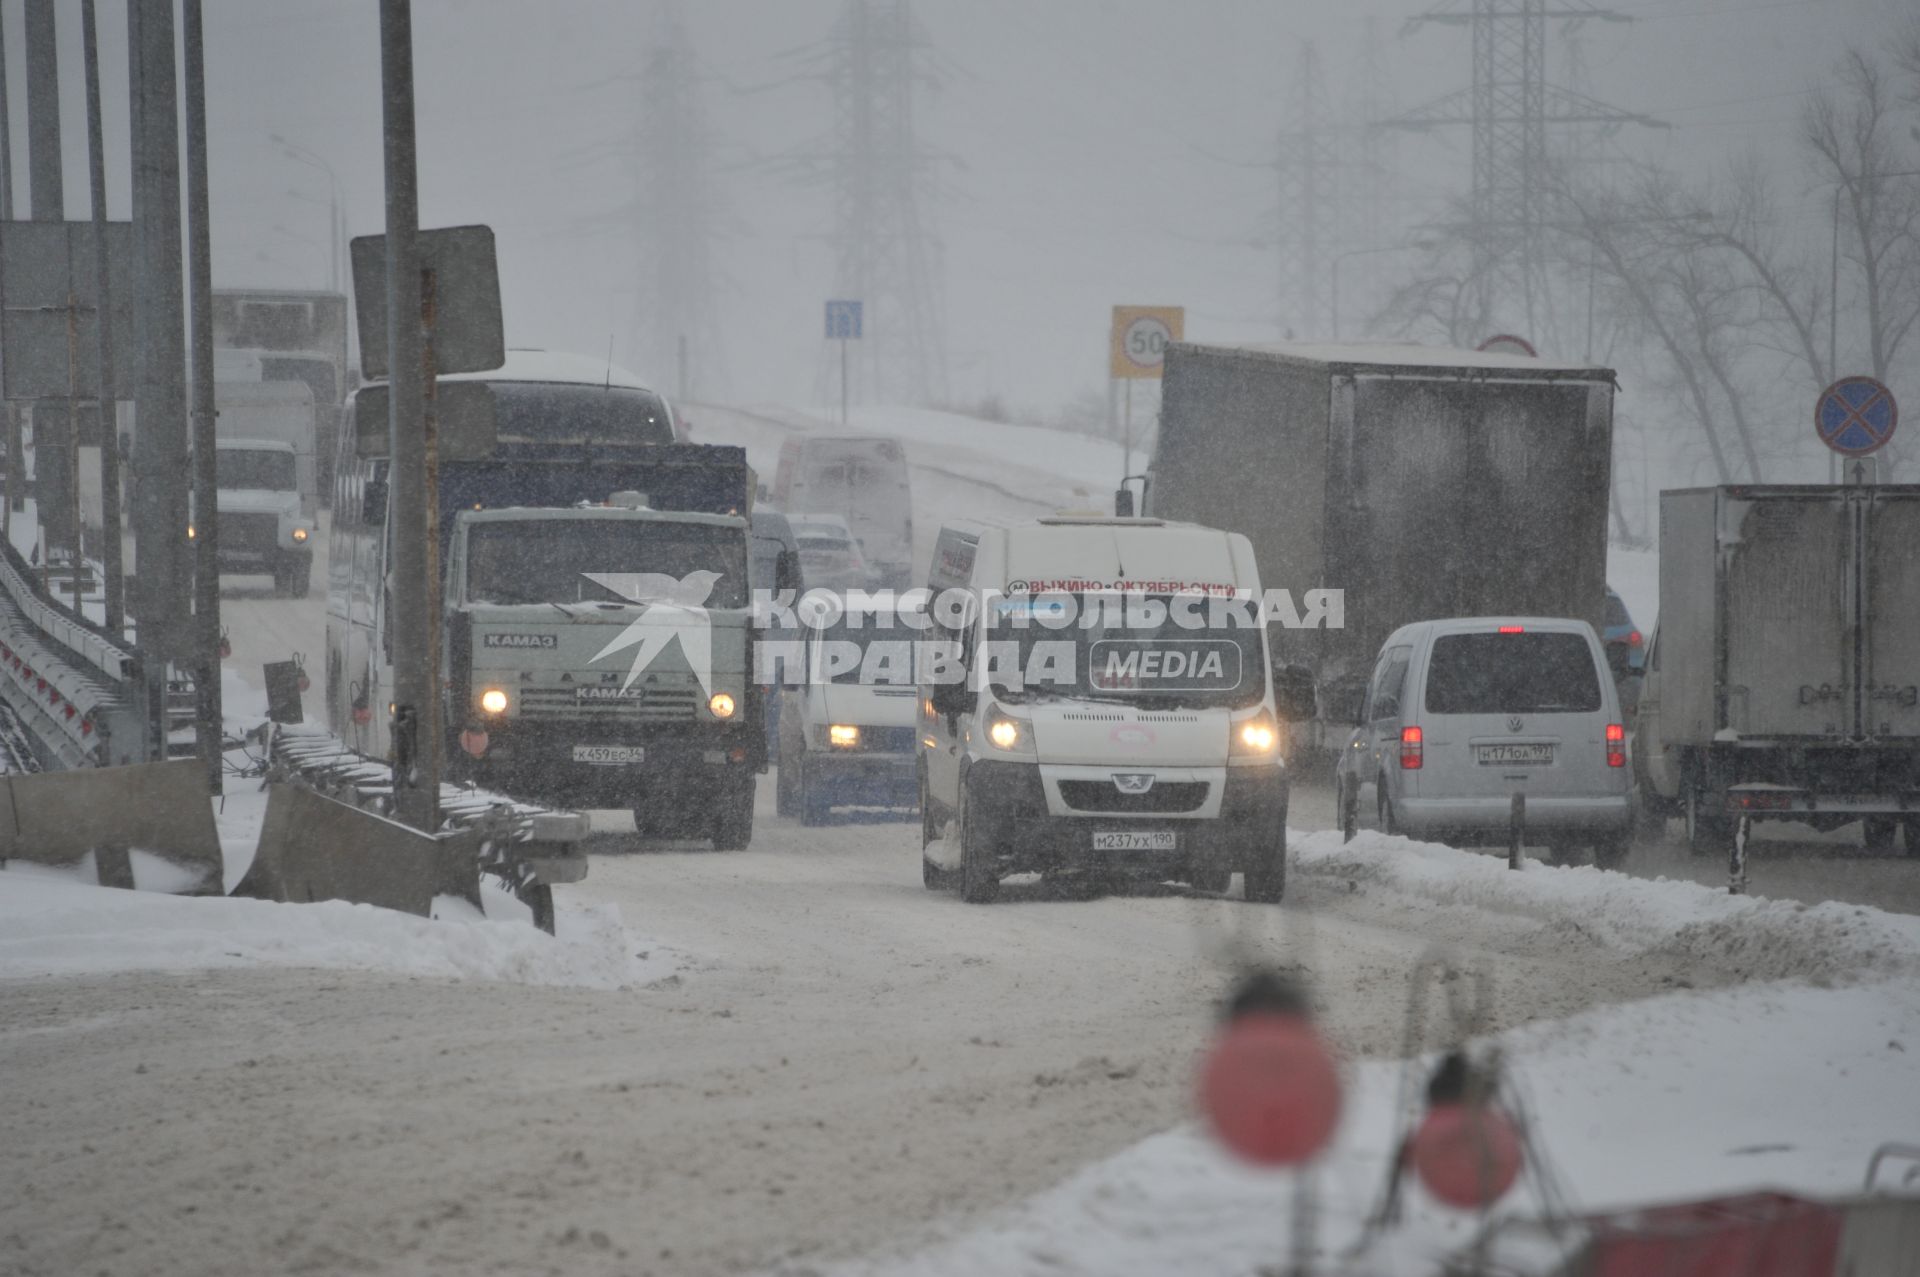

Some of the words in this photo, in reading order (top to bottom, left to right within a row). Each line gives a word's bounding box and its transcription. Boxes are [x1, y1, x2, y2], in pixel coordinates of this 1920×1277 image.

[1130, 331, 1164, 355] 50
[1030, 580, 1103, 594] ВЫХИНО
[488, 635, 554, 646] КАМАЗ
[576, 687, 642, 699] KAMAZ
